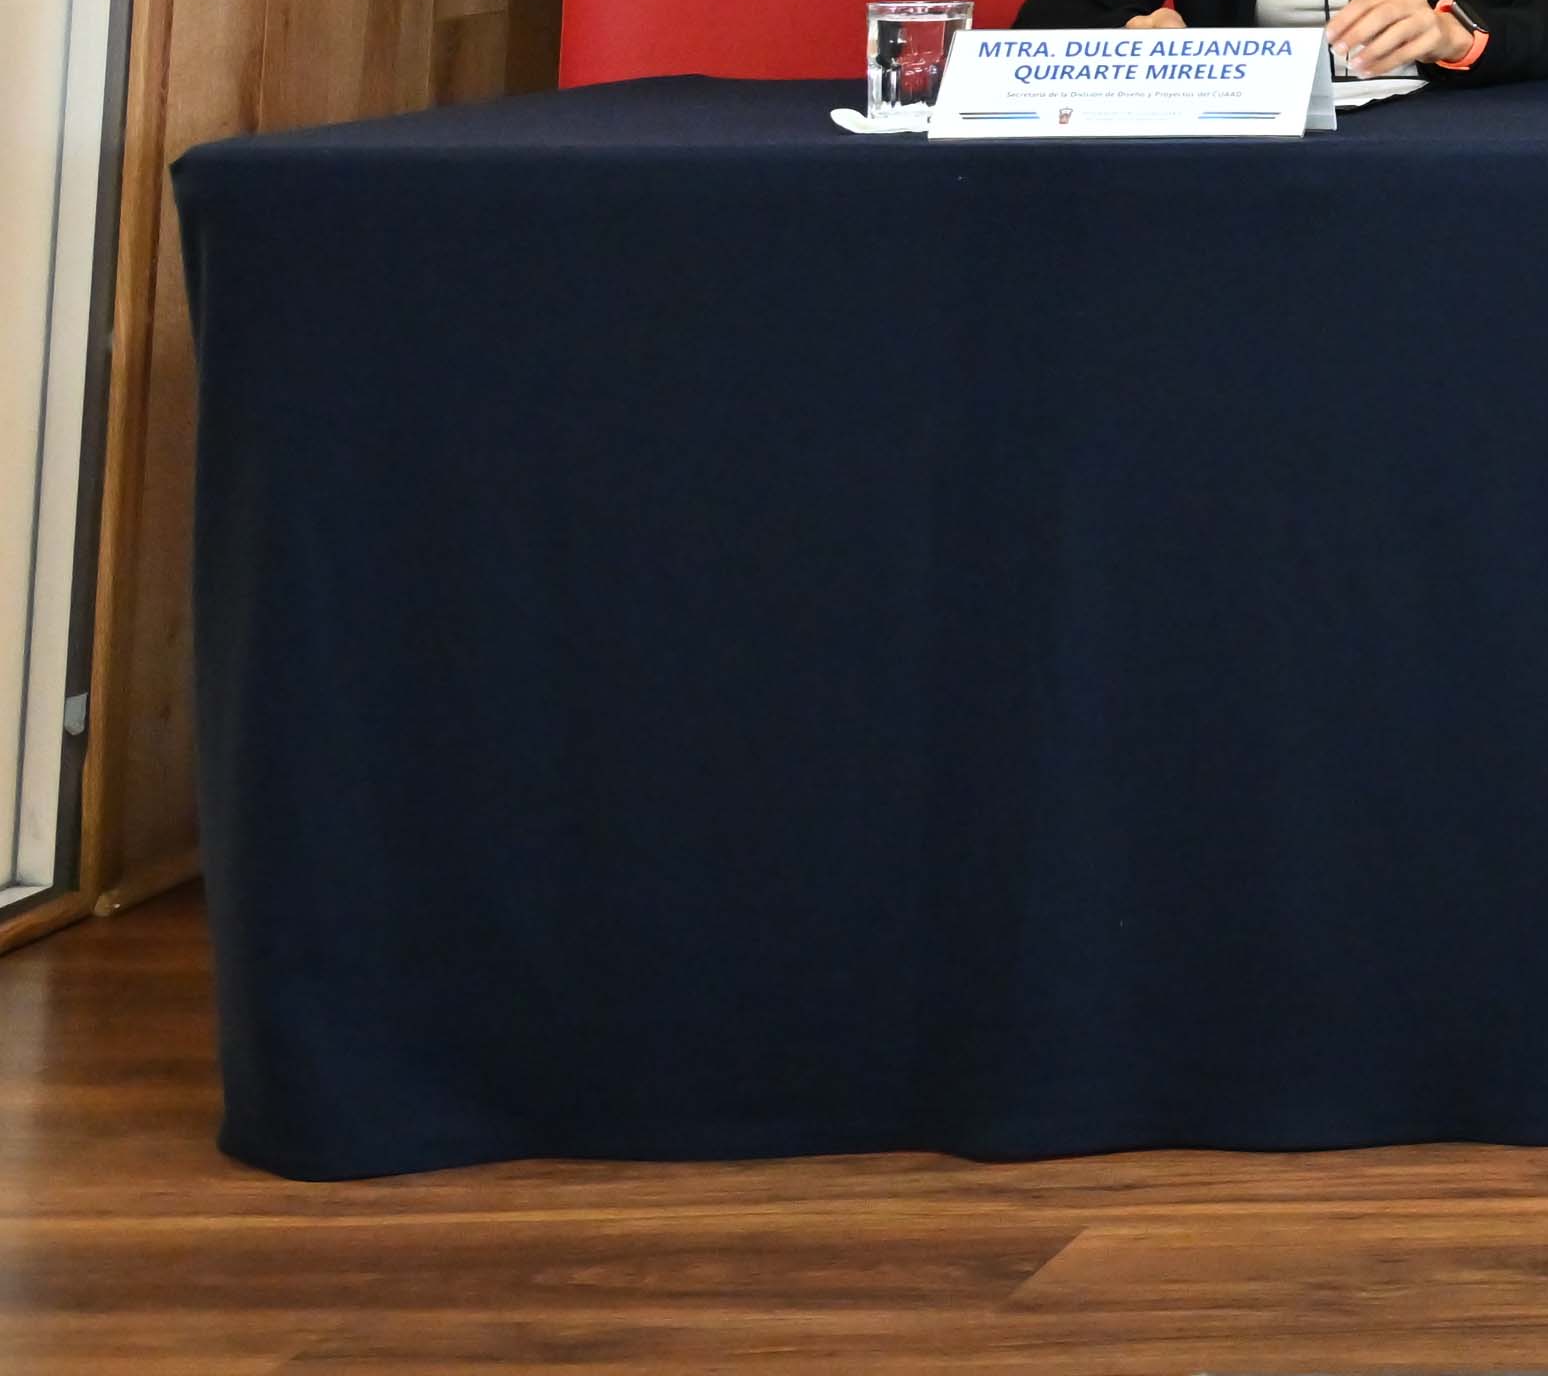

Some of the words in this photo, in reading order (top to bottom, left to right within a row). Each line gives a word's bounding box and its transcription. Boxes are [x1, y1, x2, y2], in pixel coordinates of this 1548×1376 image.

[978, 42, 1056, 58] MTRA.
[1066, 41, 1144, 58] DULCE
[1151, 40, 1294, 57] ALEJANDRA
[1014, 64, 1139, 84] QUIRARTE
[1145, 64, 1247, 81] MIRELES
